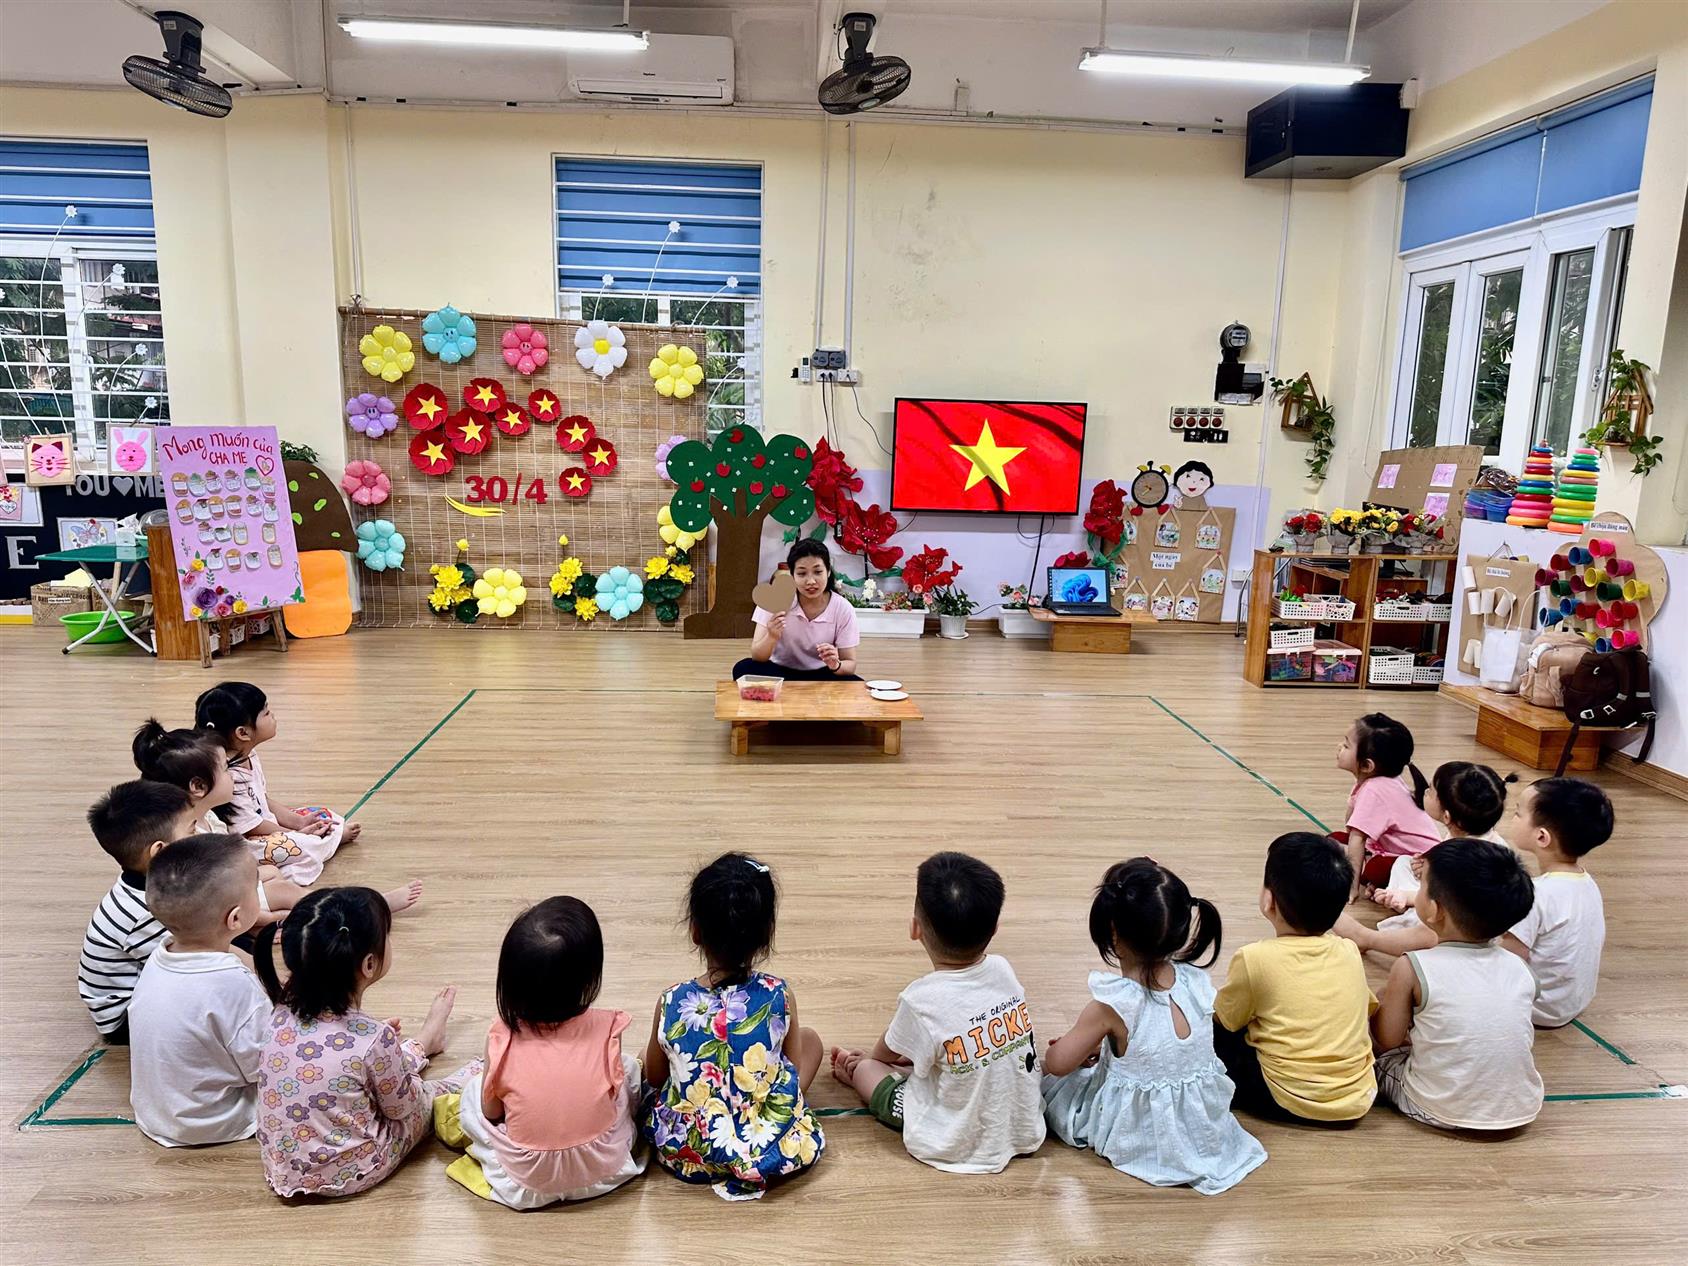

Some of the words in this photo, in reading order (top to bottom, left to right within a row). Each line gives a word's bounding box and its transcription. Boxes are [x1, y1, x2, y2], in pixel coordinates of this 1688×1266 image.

[162, 435, 208, 461] Mong
[253, 438, 273, 455] của
[209, 451, 230, 465] CHA
[233, 451, 248, 466] MẸ
[134, 475, 165, 498] ME
[465, 472, 548, 505] 30/4
[5, 535, 40, 570] E
[969, 1012, 987, 1025] THE
[990, 996, 1020, 1016] ORIGINAL
